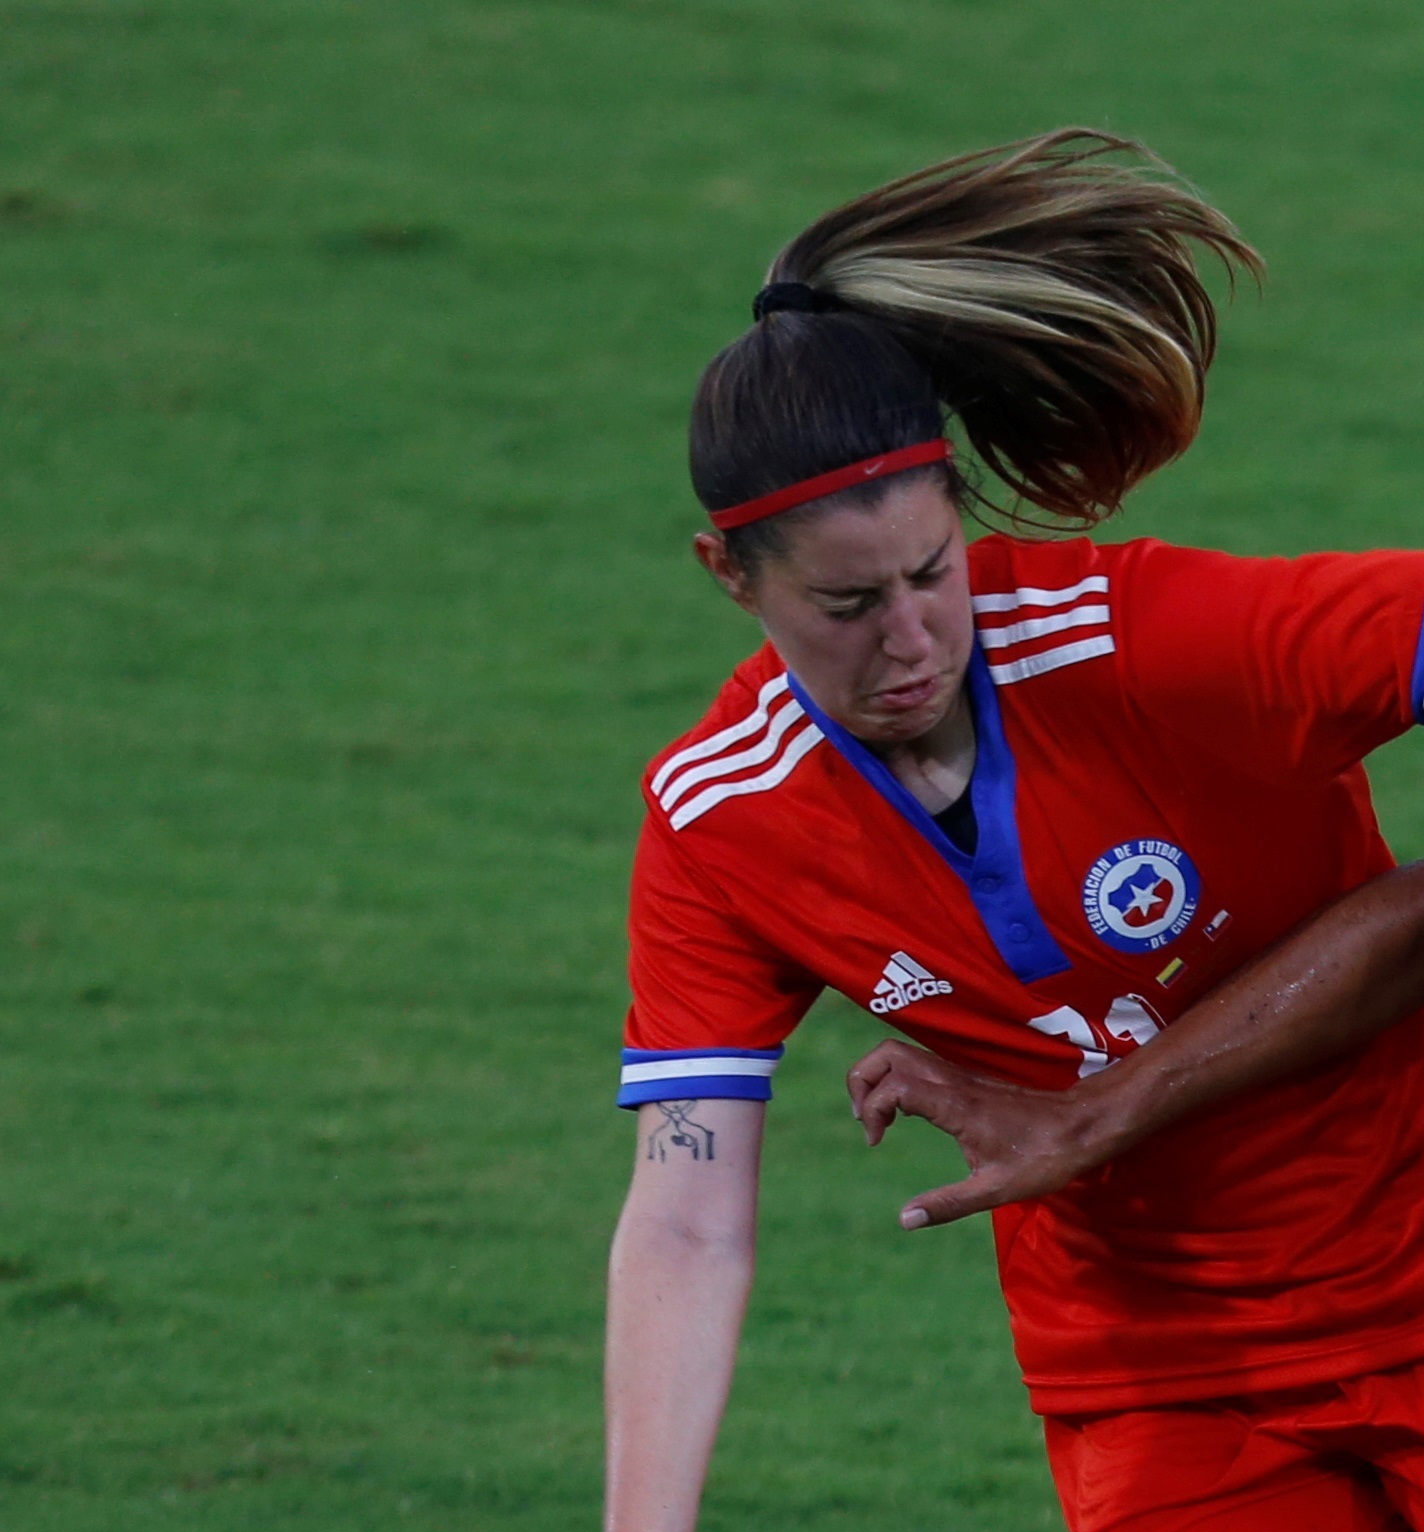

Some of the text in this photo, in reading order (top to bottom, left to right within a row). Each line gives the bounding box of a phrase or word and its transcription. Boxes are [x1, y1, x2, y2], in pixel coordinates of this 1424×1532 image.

[1083, 840, 1183, 935] FEDERACION DE FUTBOL
[1150, 902, 1197, 949] DE CHILE
[869, 976, 953, 1014] adidas
